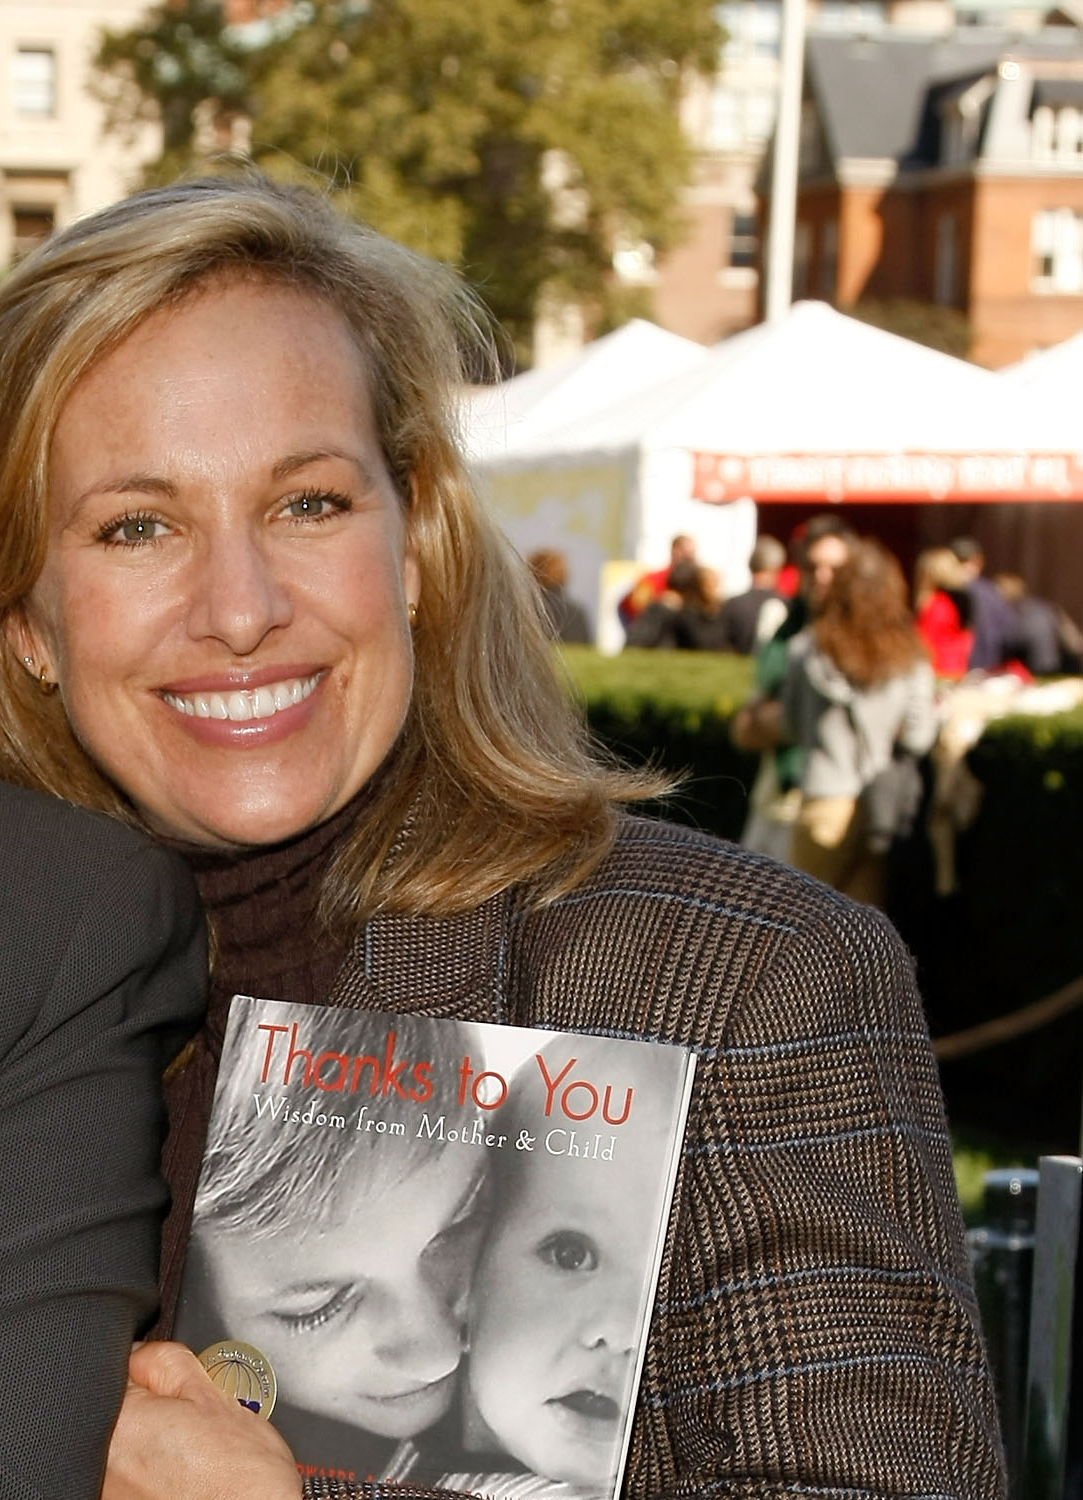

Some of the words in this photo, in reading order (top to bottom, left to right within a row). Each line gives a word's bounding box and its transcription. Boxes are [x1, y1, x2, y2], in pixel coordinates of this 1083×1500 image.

[257, 1022, 434, 1103] Thanks
[457, 1055, 509, 1111] to
[534, 1053, 635, 1127] You
[252, 1093, 346, 1129] Wisdom
[355, 1107, 406, 1137] from
[414, 1113, 508, 1149] Mother
[515, 1130, 537, 1152] &
[544, 1129, 617, 1162] Child
